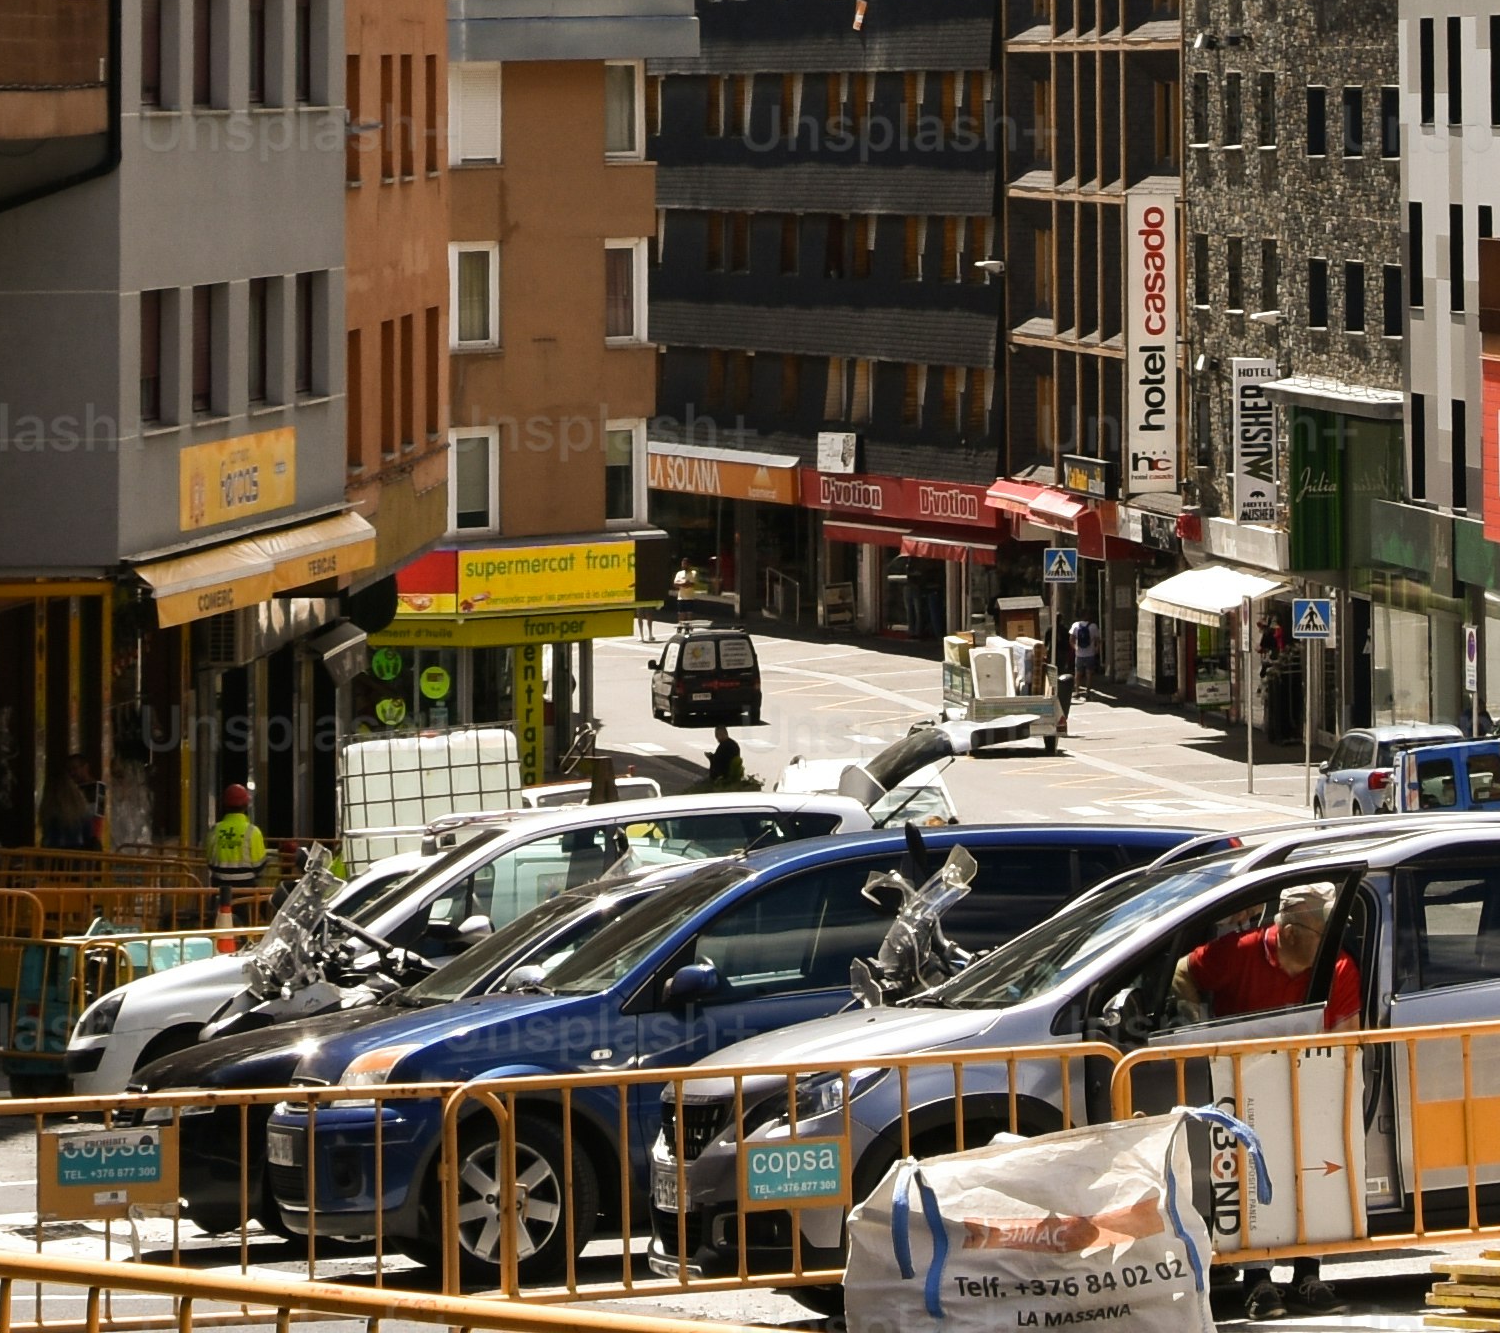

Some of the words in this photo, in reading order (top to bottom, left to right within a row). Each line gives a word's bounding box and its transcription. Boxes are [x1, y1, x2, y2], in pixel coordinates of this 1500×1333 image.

[1138, 205, 1166, 336] casado
[1138, 344, 1166, 432] hotel
[1238, 367, 1274, 378] HOTEL
[666, 457, 721, 494] SOLANA
[820, 475, 883, 510] D'votion
[919, 486, 979, 520] D'votion
[465, 552, 575, 581] supermercat
[523, 645, 537, 786] entrada
[63, 1170, 87, 1180] TEL.
[752, 1148, 835, 1179] copsa
[753, 1184, 776, 1195] TEL.
[955, 1275, 1008, 1299] Telf.
[1015, 1274, 1080, 1297] +376
[1085, 1271, 1118, 1294] 84
[1122, 1265, 1153, 1288] 02
[1155, 1258, 1188, 1281] 02
[1016, 1310, 1039, 1327] LA
[1044, 1303, 1132, 1327] MASSANA
